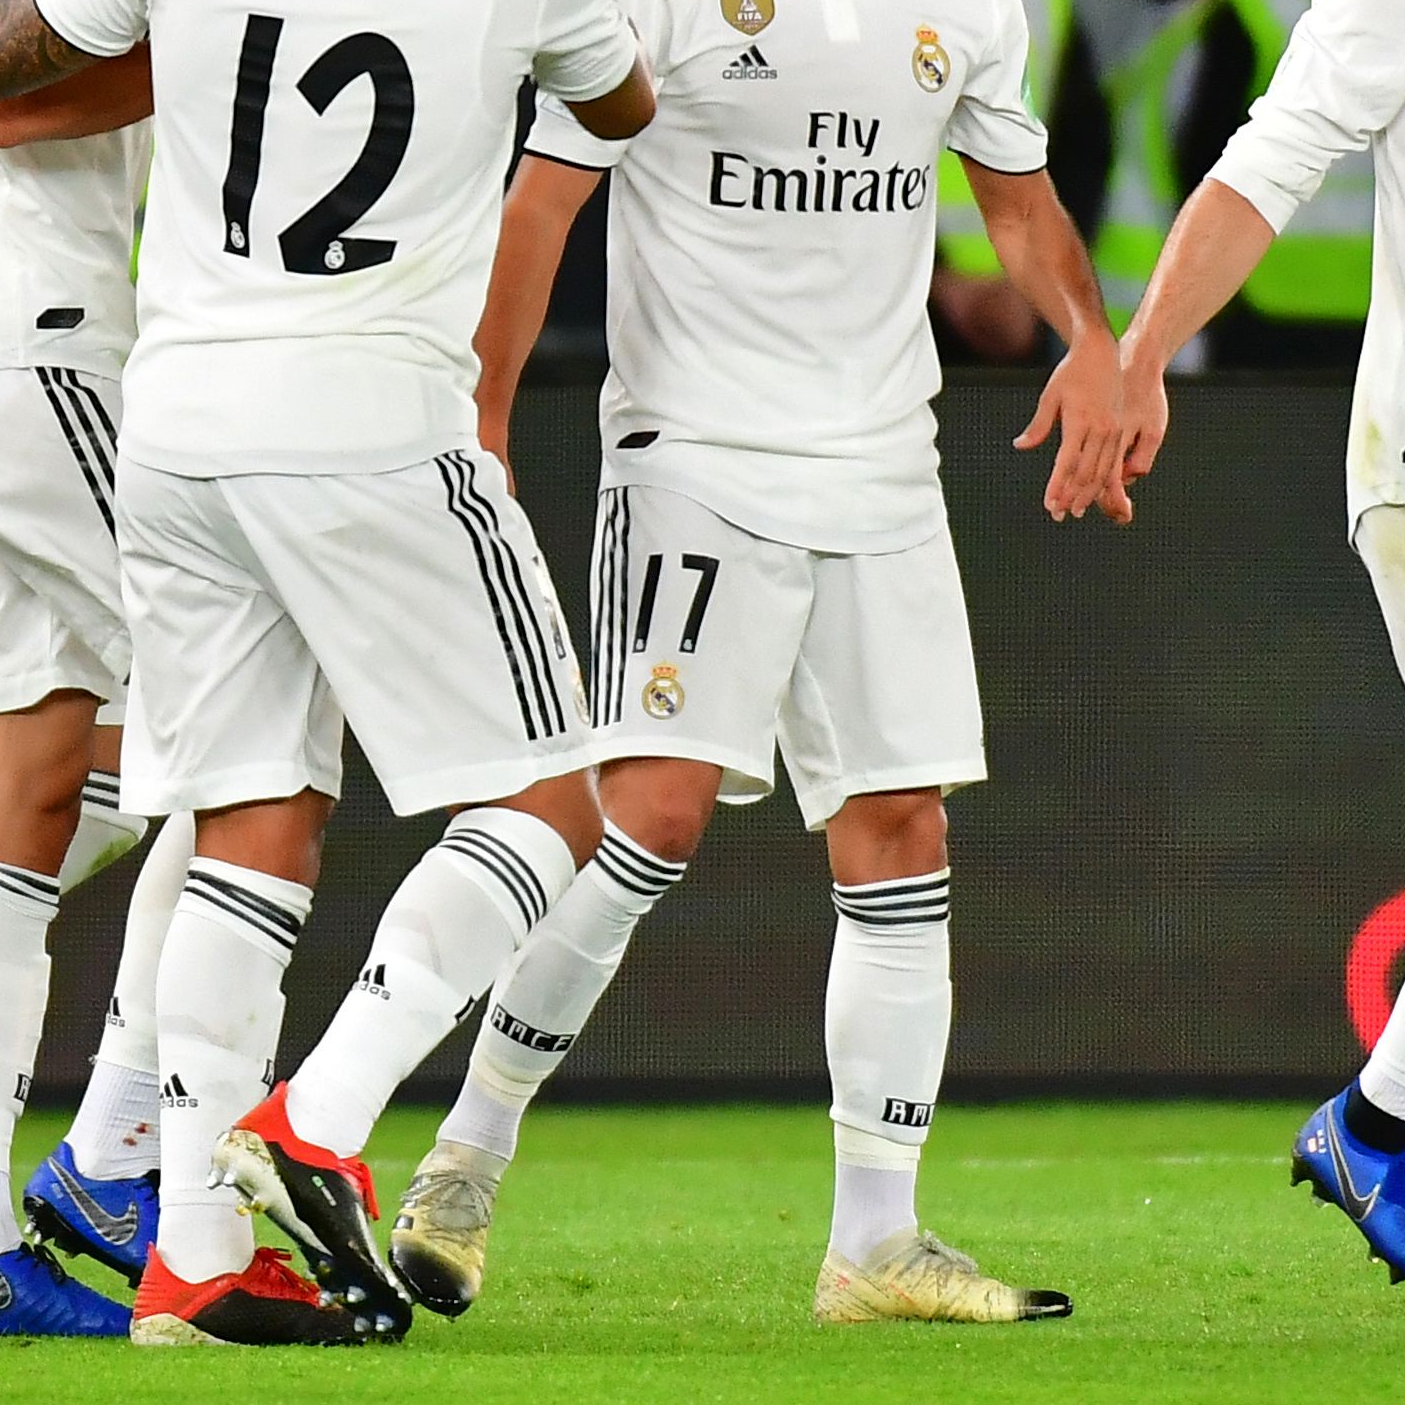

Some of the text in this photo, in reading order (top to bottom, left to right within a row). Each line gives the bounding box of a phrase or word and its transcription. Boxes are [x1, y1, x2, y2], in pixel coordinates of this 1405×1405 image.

[721, 64, 778, 80] adidas
[223, 13, 416, 276] 12
[807, 111, 881, 157] Fly
[709, 150, 931, 213] Emirates
[632, 552, 721, 654] 17
[491, 1005, 572, 1051] RMCF
